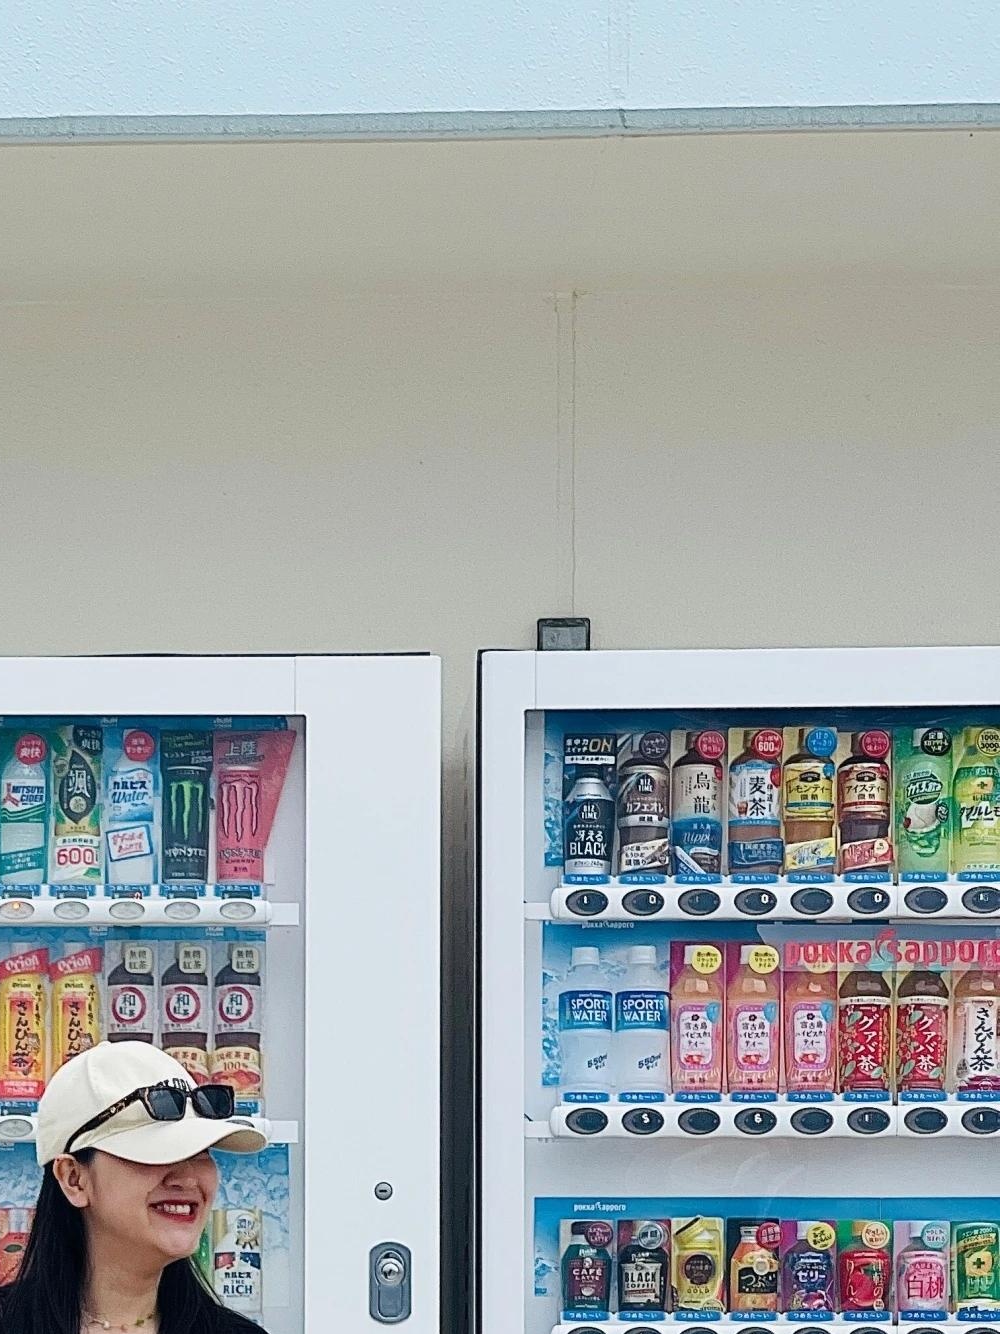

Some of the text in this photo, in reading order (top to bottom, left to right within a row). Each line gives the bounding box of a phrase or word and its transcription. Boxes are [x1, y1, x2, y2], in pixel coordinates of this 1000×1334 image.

[12, 785, 45, 795] MITSUYA
[112, 780, 148, 791] カルピス
[788, 784, 831, 794] レモンティー
[844, 784, 887, 794] アイスティー
[20, 794, 44, 803] CIDER
[111, 790, 148, 804] Water
[749, 776, 767, 817] 麦茶
[625, 801, 665, 814] カフェオレ
[574, 829, 604, 842] 冴える
[569, 841, 607, 857] BLACK
[56, 847, 94, 866] 600
[5, 954, 40, 971] Orion
[57, 954, 92, 972] Orion
[129, 960, 148, 970] 紅茶
[182, 960, 202, 970] 紅茶
[235, 960, 255, 970] 紅茶
[121, 993, 136, 1007] 和
[175, 993, 190, 1007] 和
[229, 993, 243, 1007] 和
[571, 998, 610, 1010] SPORTS
[622, 998, 664, 1010] SPORTS
[118, 1005, 137, 1018] 紅茶
[173, 1005, 190, 1018] 紅茶
[225, 1005, 243, 1018] 紅茶
[572, 1010, 607, 1022] WATER
[623, 1010, 661, 1022] WATER
[12, 1000, 31, 1068] さんぴん茶
[969, 1007, 995, 1072] さんぴん茶
[856, 1013, 880, 1073] グァバ茶
[917, 1013, 939, 1073] グァバ茶
[224, 1271, 252, 1279] カルピス
[624, 1271, 657, 1283] BLACK
[796, 1270, 826, 1283] ゼリー
[222, 1284, 254, 1295] RICH
[907, 1276, 944, 1300] 白桃
